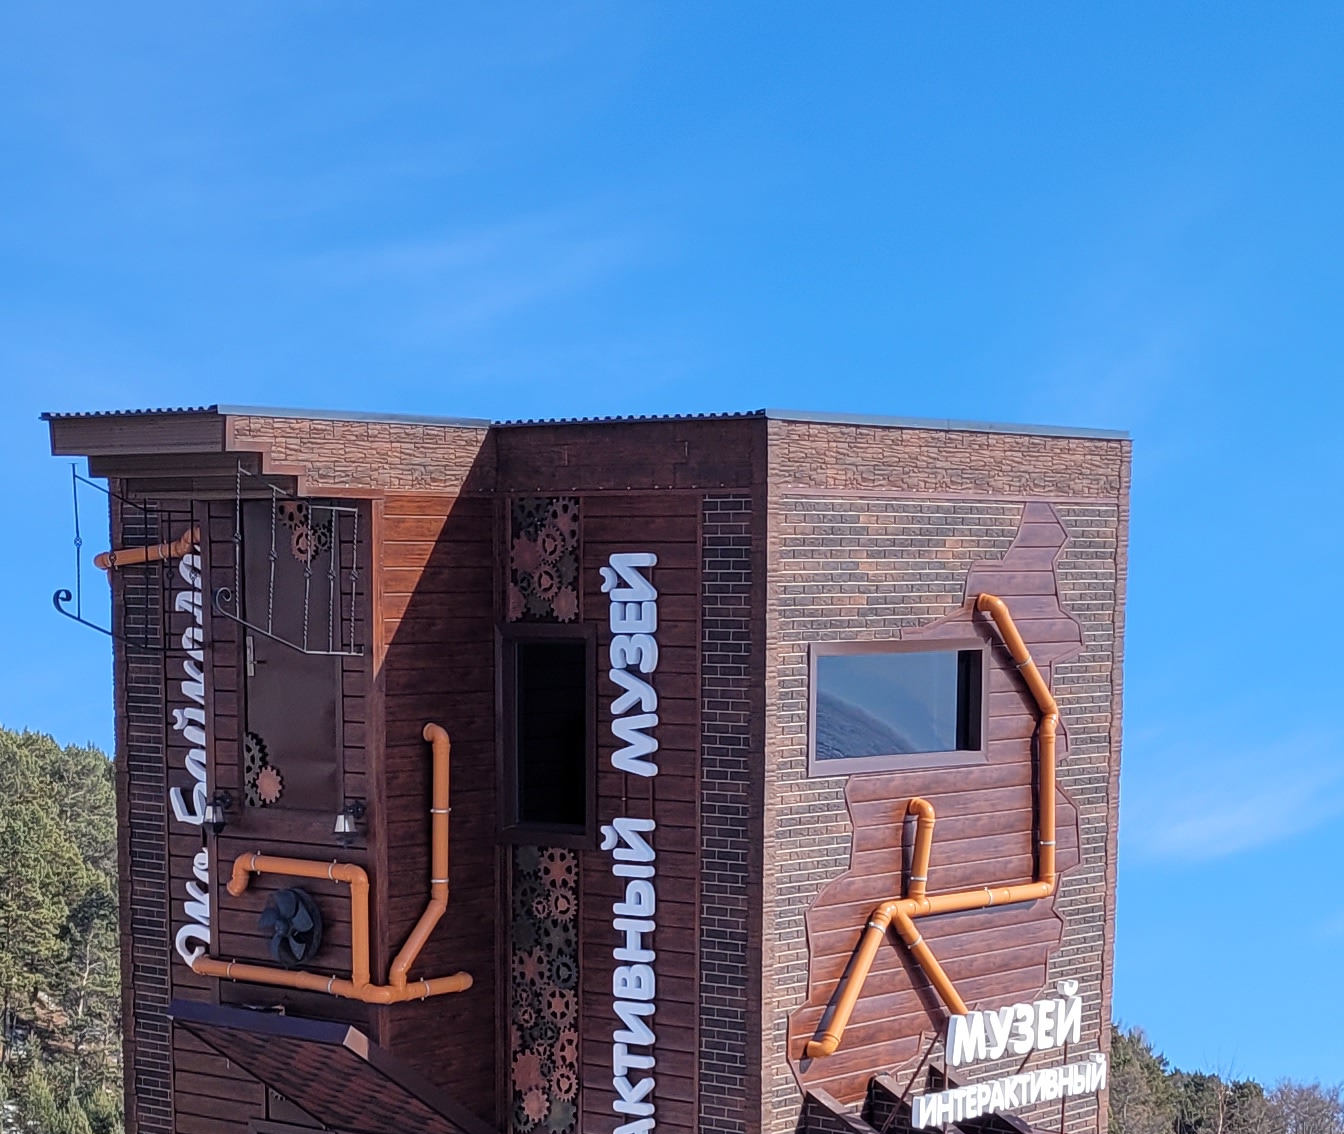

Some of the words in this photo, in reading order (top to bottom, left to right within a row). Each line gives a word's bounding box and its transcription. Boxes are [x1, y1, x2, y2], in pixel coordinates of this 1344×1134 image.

[600, 552, 658, 777] МУЗЕЙ
[946, 980, 1082, 1066] МУЗЕЙ
[912, 1053, 1106, 1129] ИНТЕРАКТИВНЫЙ
